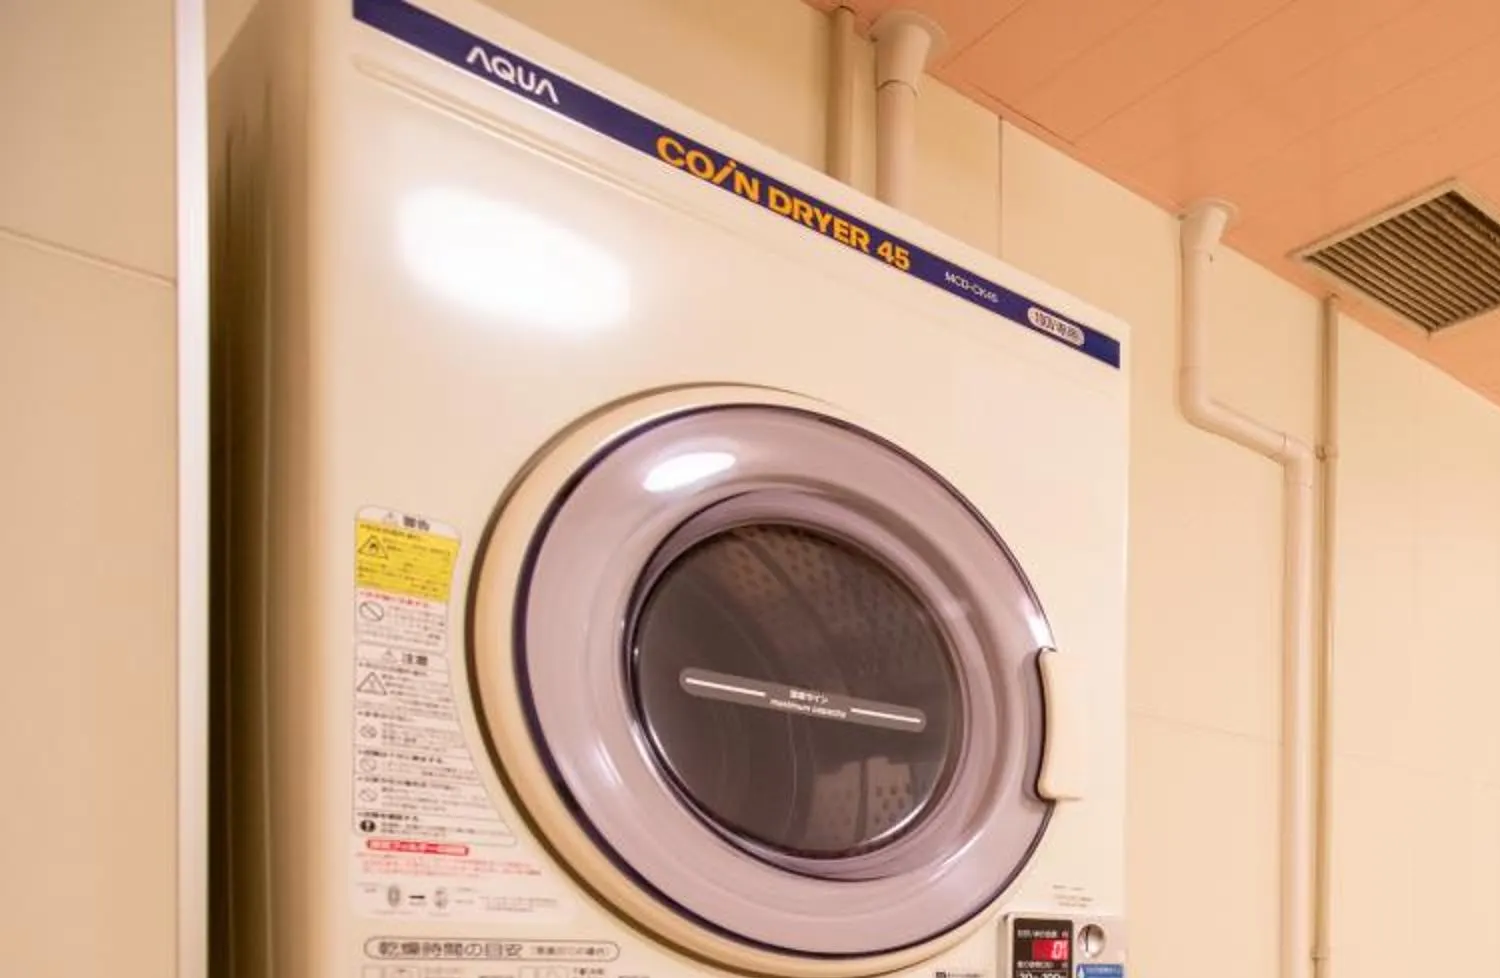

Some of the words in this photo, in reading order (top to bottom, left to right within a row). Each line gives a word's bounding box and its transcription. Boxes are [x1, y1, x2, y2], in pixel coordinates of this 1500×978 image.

[466, 46, 560, 105] AQUA
[768, 184, 871, 254] DRYER
[876, 240, 911, 271] 45
